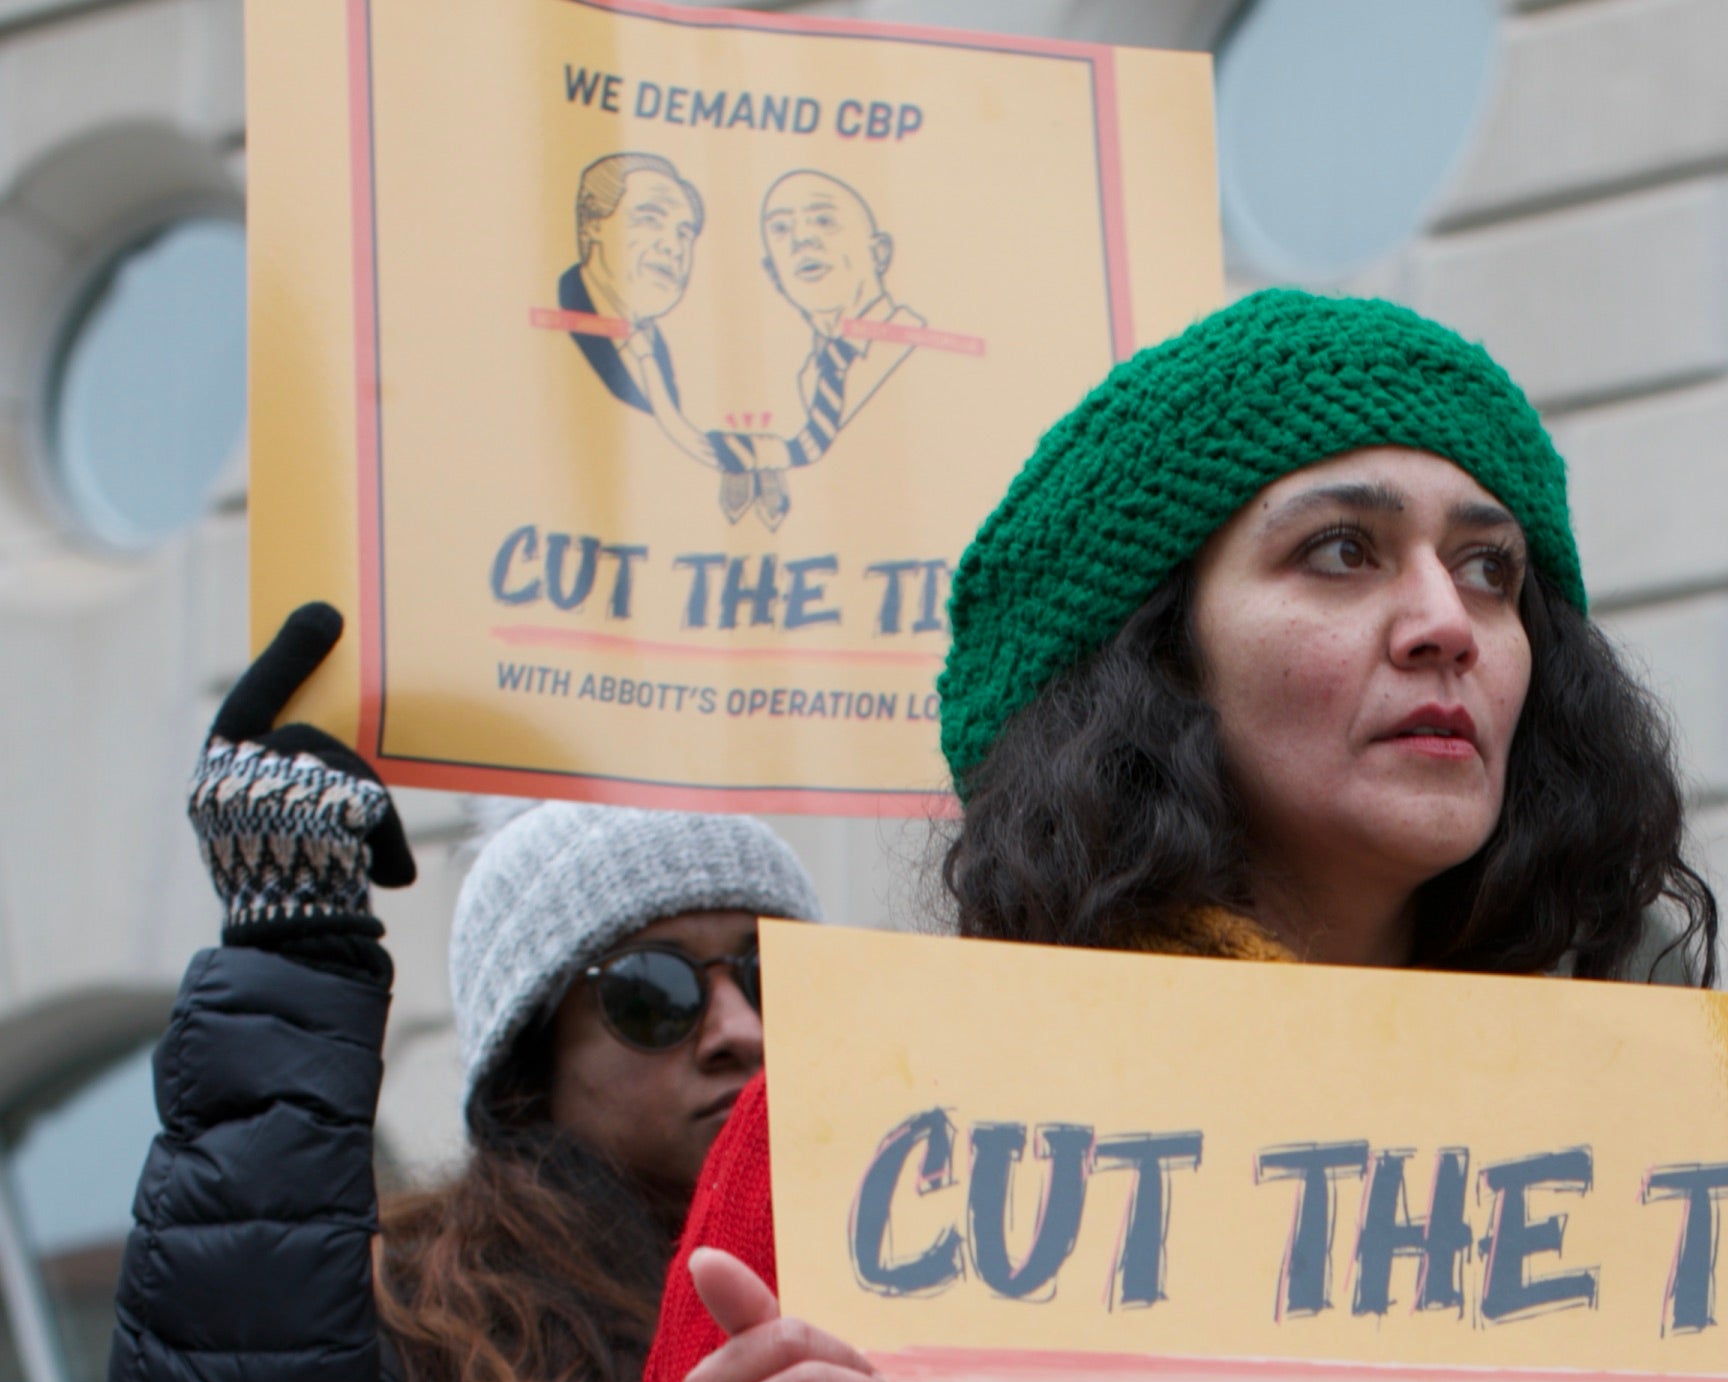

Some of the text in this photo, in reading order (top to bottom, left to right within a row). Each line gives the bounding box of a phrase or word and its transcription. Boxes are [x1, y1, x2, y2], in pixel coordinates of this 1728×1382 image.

[564, 62, 924, 142] WE DEMAND CBP
[489, 524, 957, 639] CUT THE TI
[496, 661, 571, 699] WITH
[577, 671, 719, 715] ABBOTT'S
[726, 687, 898, 723] OPERATION
[848, 1105, 1205, 1313] CUT
[1254, 1140, 1601, 1332] THE
